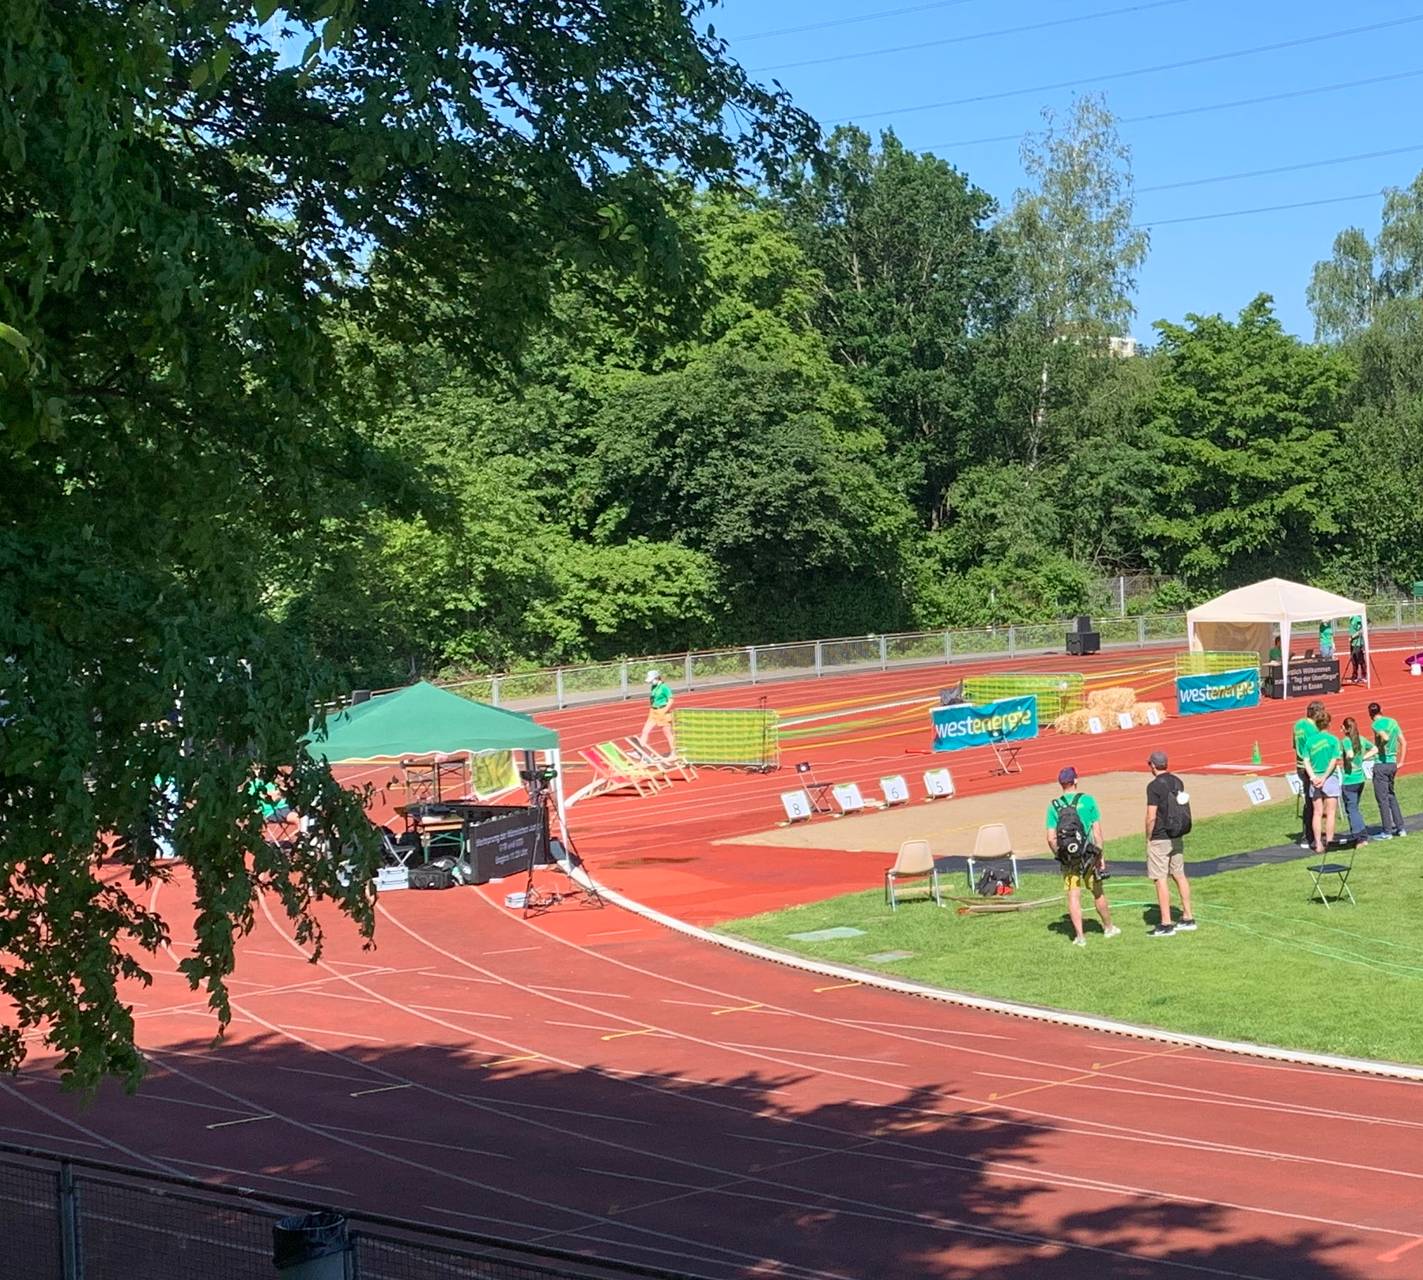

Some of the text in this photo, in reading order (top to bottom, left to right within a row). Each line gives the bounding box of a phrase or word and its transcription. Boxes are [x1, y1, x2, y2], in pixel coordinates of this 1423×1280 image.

[1180, 681, 1255, 703] westenergie
[891, 787, 900, 799] 6
[935, 781, 944, 793] 5
[1252, 787, 1265, 801] 13
[845, 796, 852, 807] 7
[792, 803, 801, 815] 8
